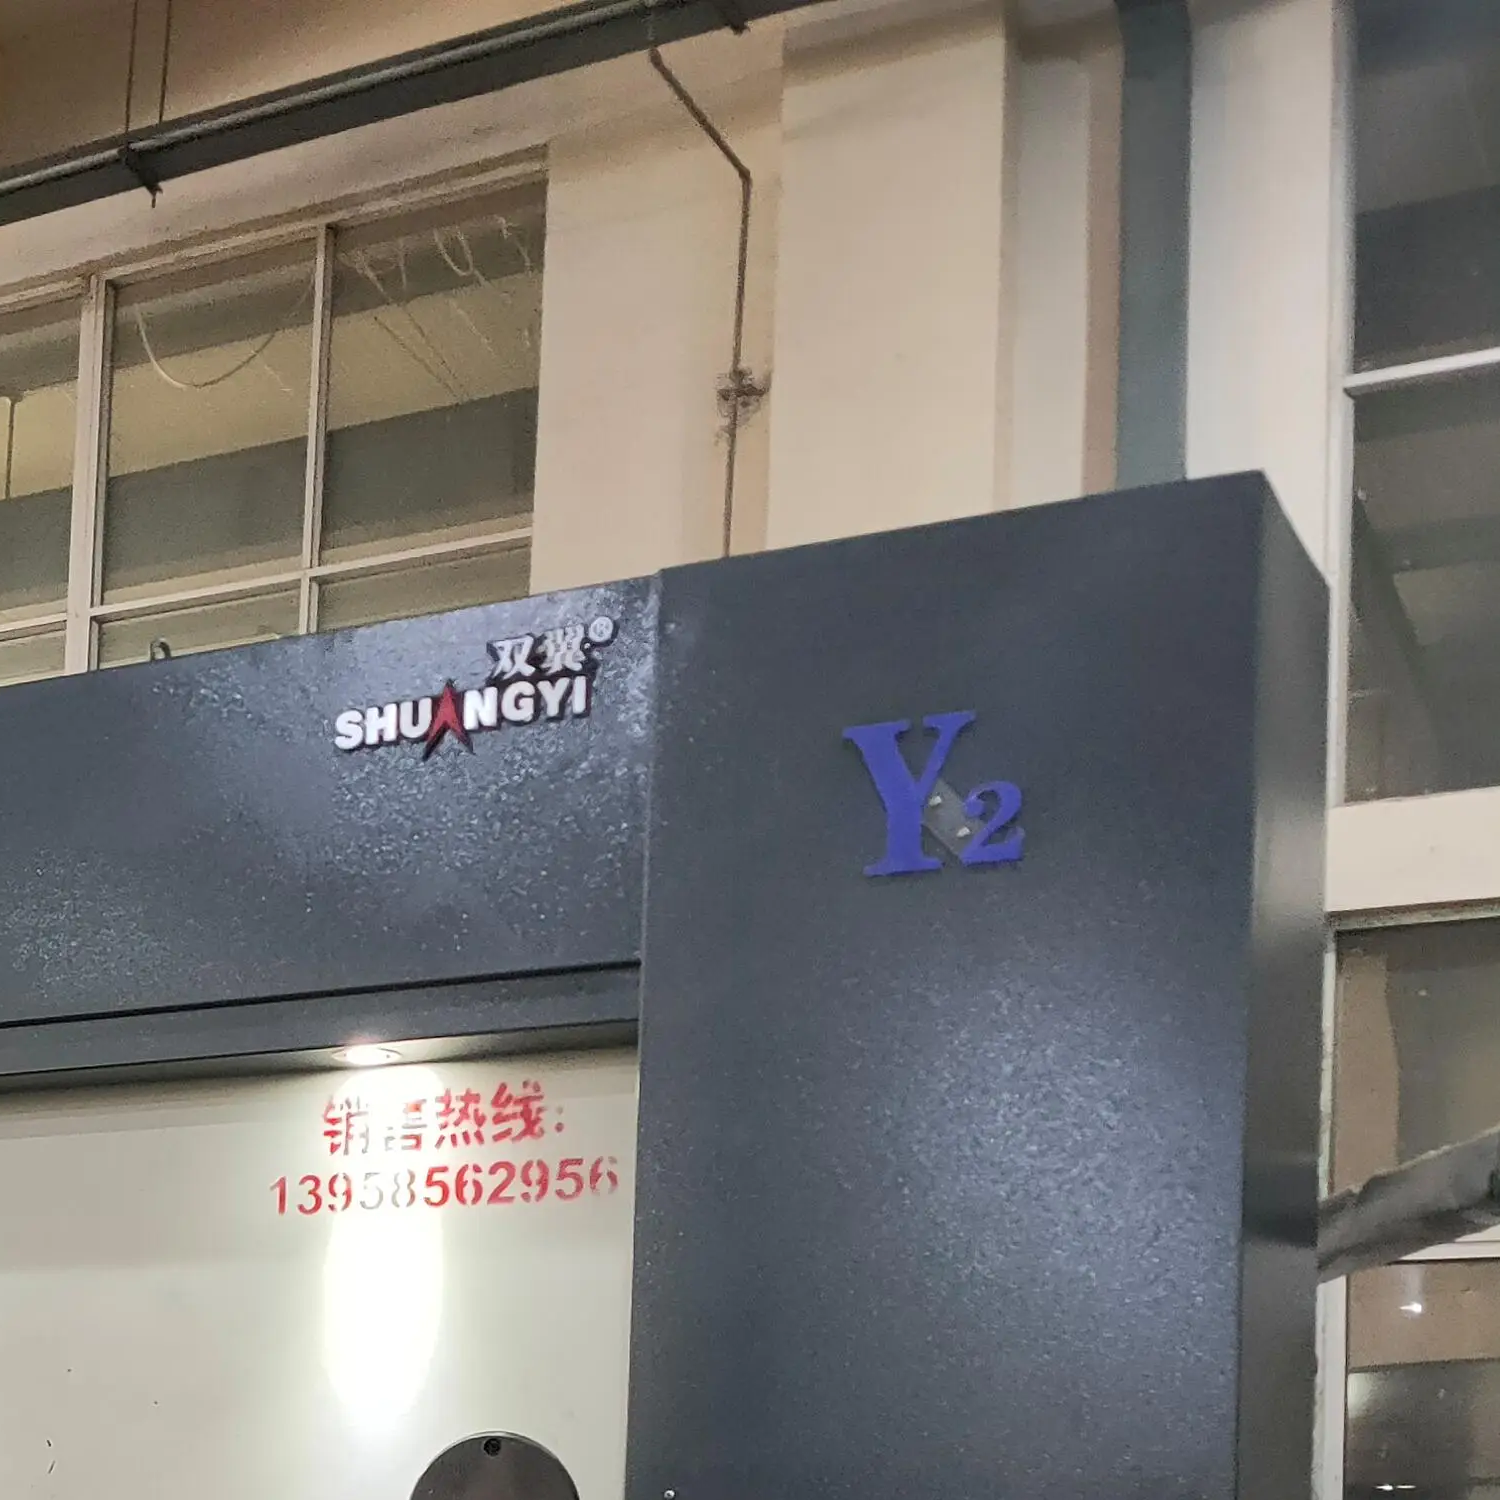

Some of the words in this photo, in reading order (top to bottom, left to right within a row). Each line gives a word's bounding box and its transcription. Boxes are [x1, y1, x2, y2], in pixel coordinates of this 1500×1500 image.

[334, 675, 587, 760] SHUANGYI
[841, 709, 1026, 878] Y2
[269, 1155, 619, 1216] 13958562956
